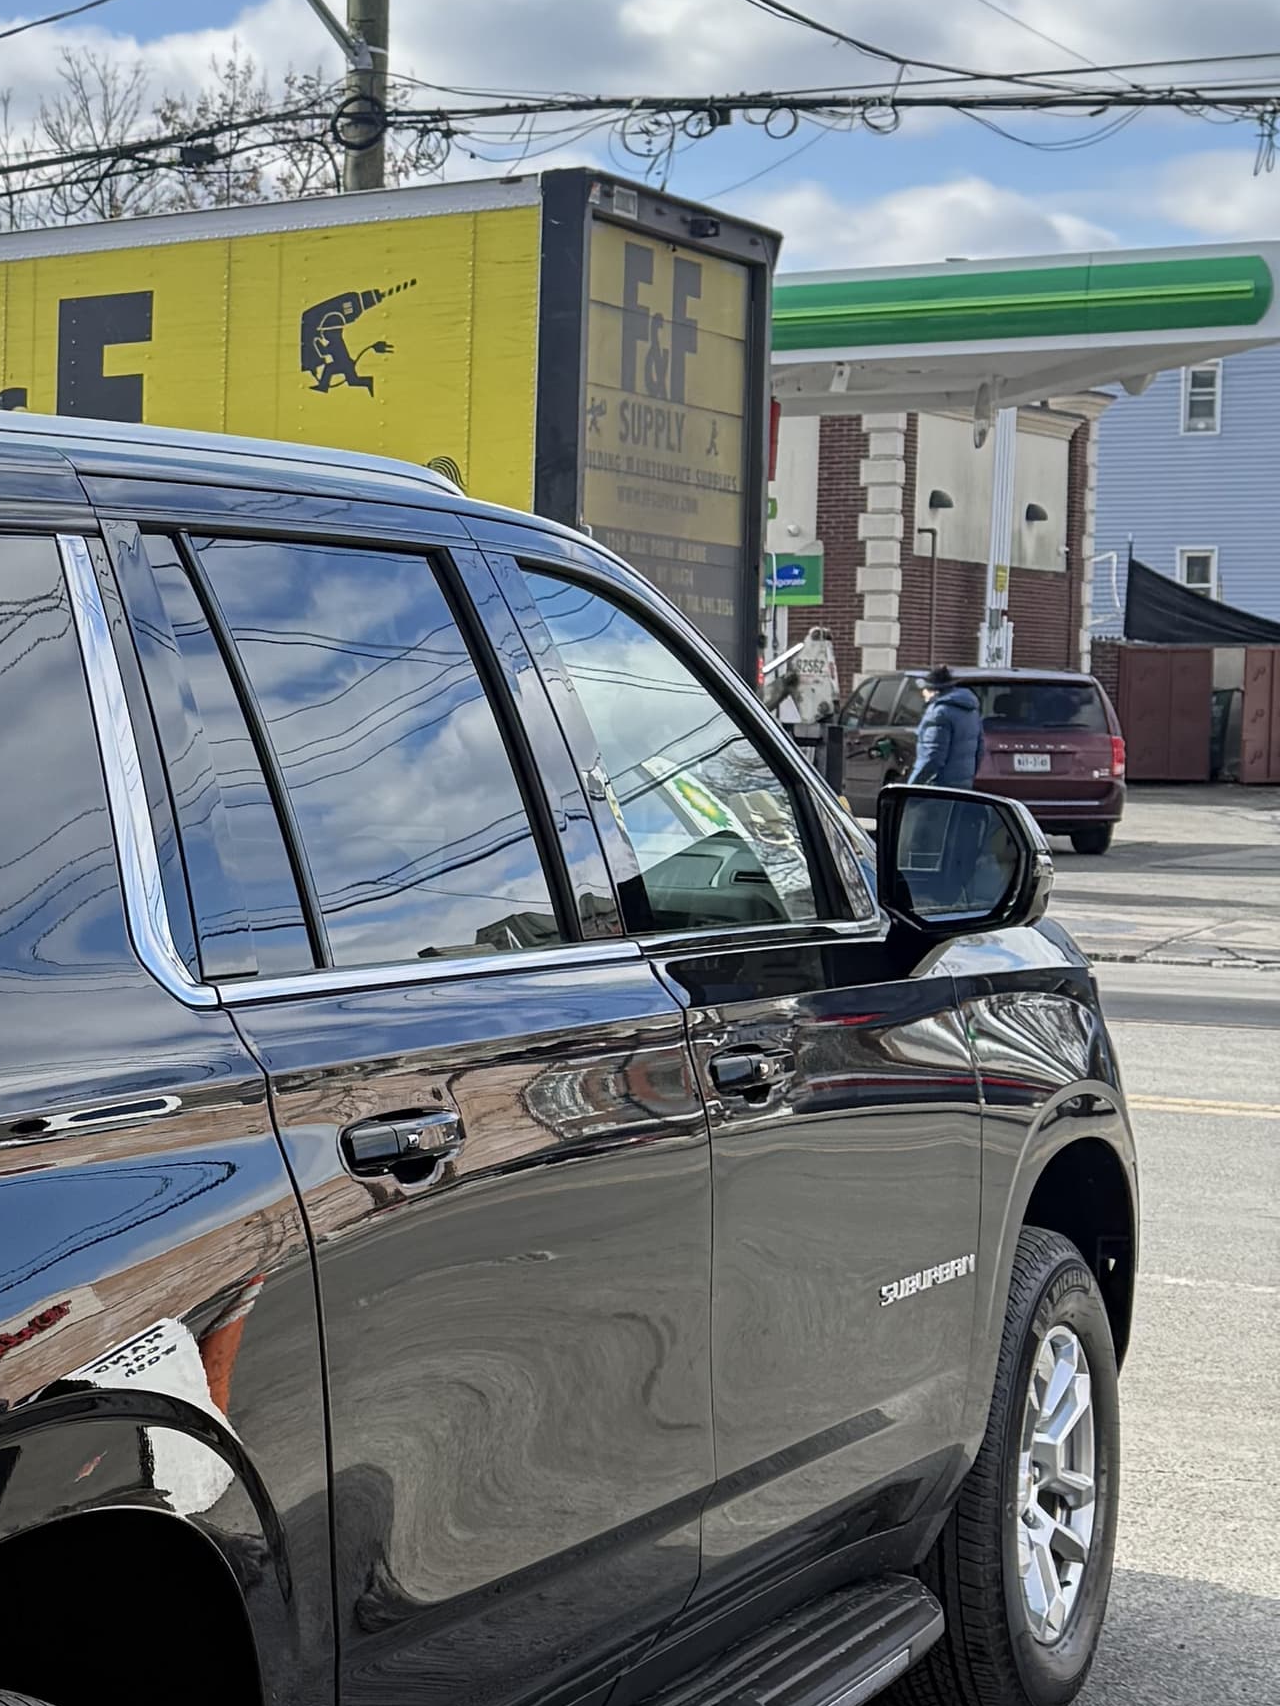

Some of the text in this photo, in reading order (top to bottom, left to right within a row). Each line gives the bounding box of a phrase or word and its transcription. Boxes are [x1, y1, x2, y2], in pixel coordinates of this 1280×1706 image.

[621, 241, 702, 405] F&F
[618, 399, 686, 453] SUPPLY
[880, 1254, 976, 1307] SUBURBAN
